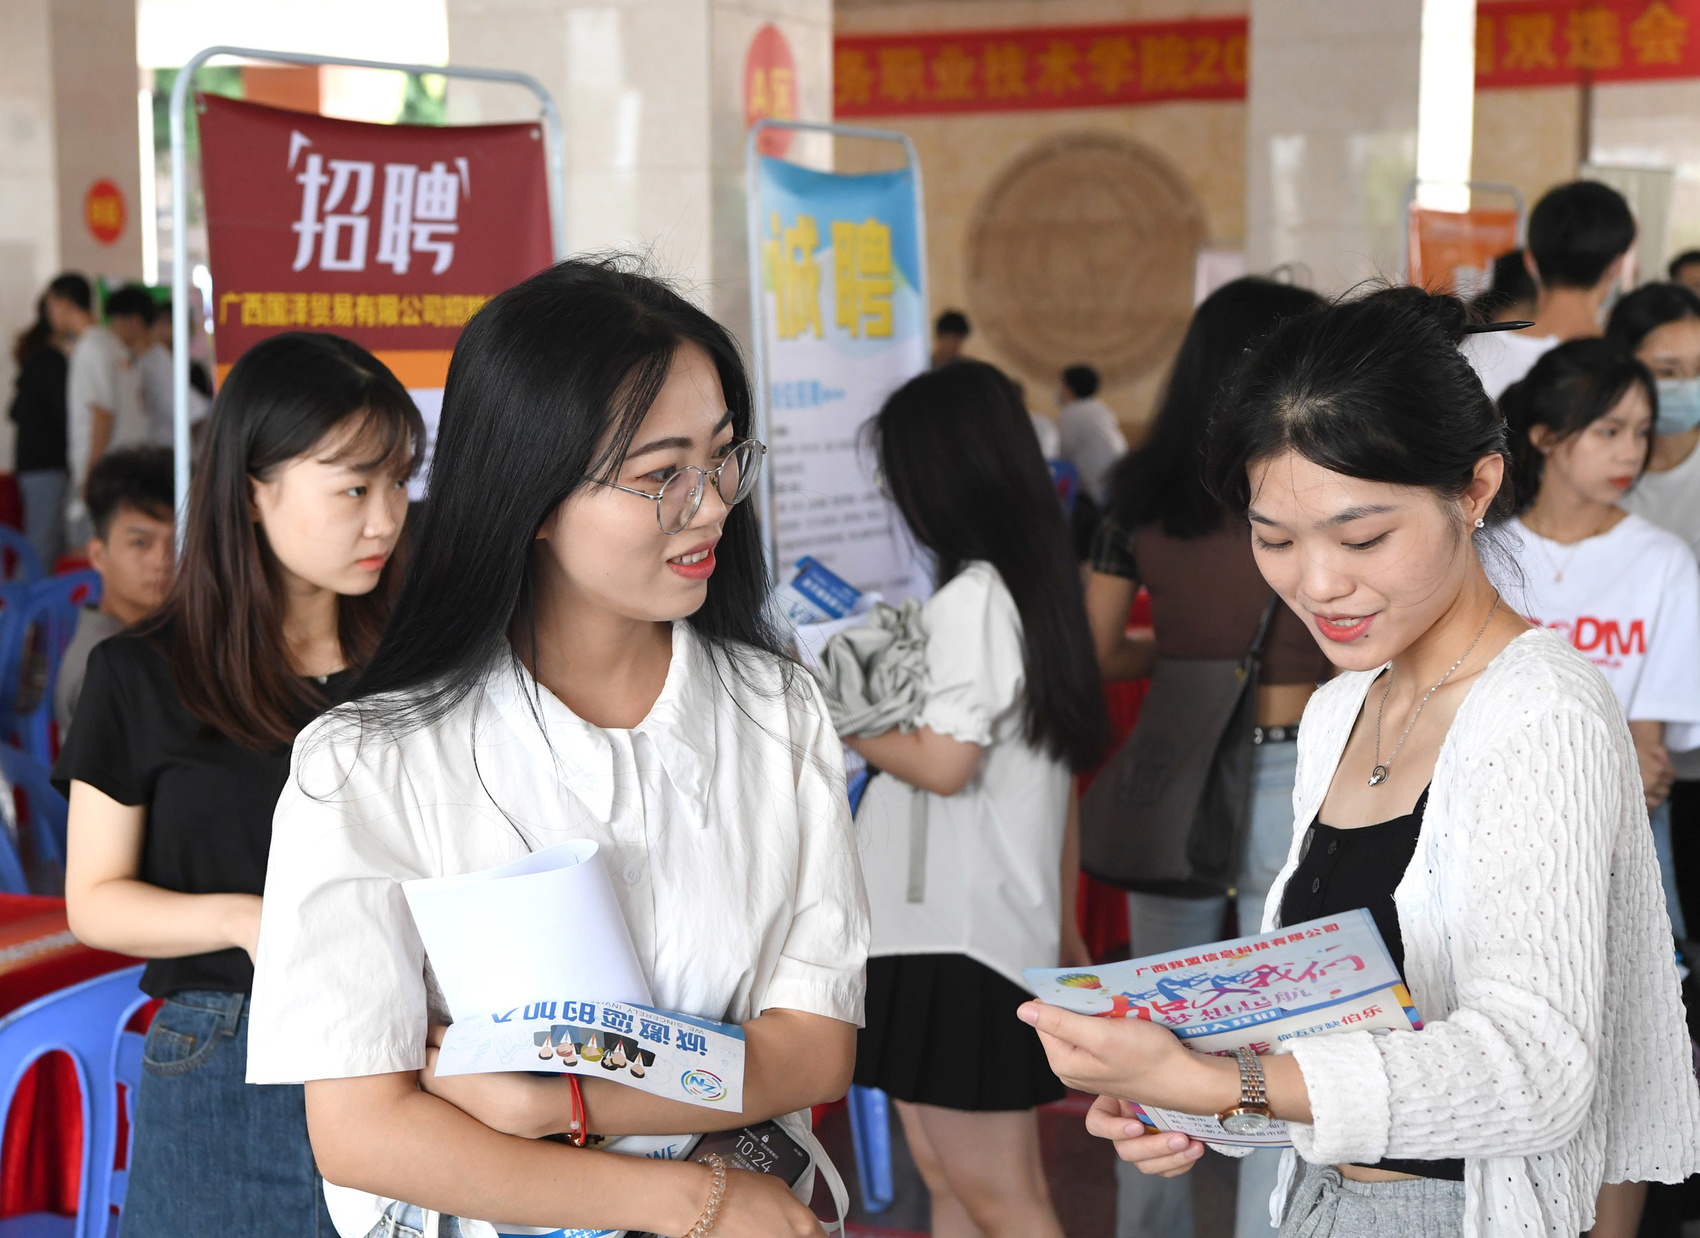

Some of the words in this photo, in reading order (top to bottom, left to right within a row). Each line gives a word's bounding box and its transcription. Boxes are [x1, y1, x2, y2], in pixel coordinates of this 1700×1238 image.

[291, 153, 460, 275] 招聘
[767, 211, 894, 339] 诚聘
[626, 1008, 683, 1029] SINCERELY
[690, 1026, 704, 1035] WE
[1185, 1010, 1278, 1036] 加入我们
[733, 1152, 757, 1172] 7月2日星期
[735, 1135, 773, 1173] 10:24
